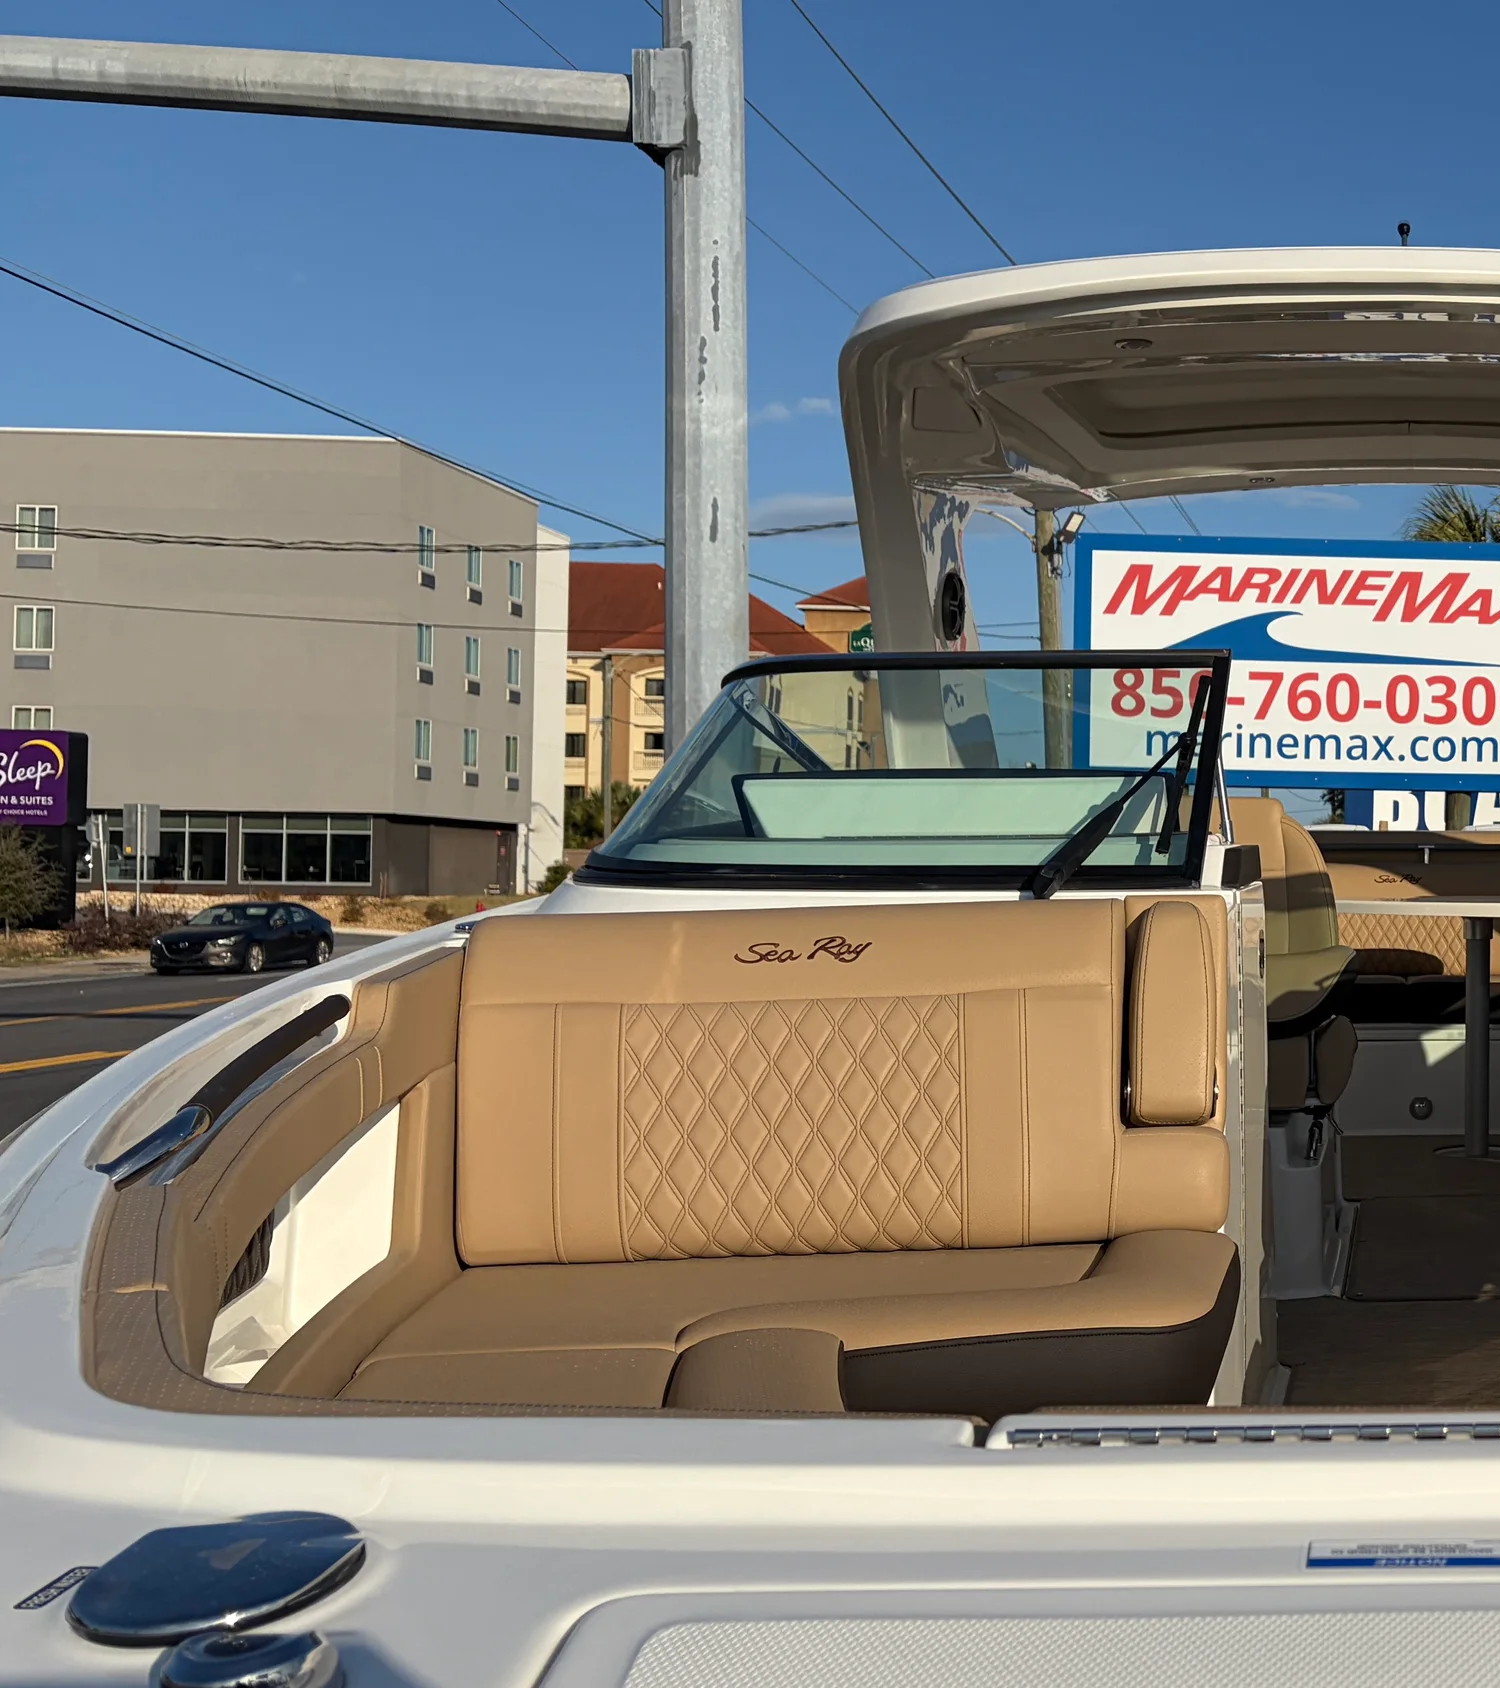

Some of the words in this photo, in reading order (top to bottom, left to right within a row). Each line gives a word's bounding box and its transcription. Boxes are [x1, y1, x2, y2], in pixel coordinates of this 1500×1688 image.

[1146, 723, 1498, 763] minemax.com
[20, 796, 53, 805] SUITES
[734, 942, 802, 964] Sea
[806, 935, 873, 964] Ray
